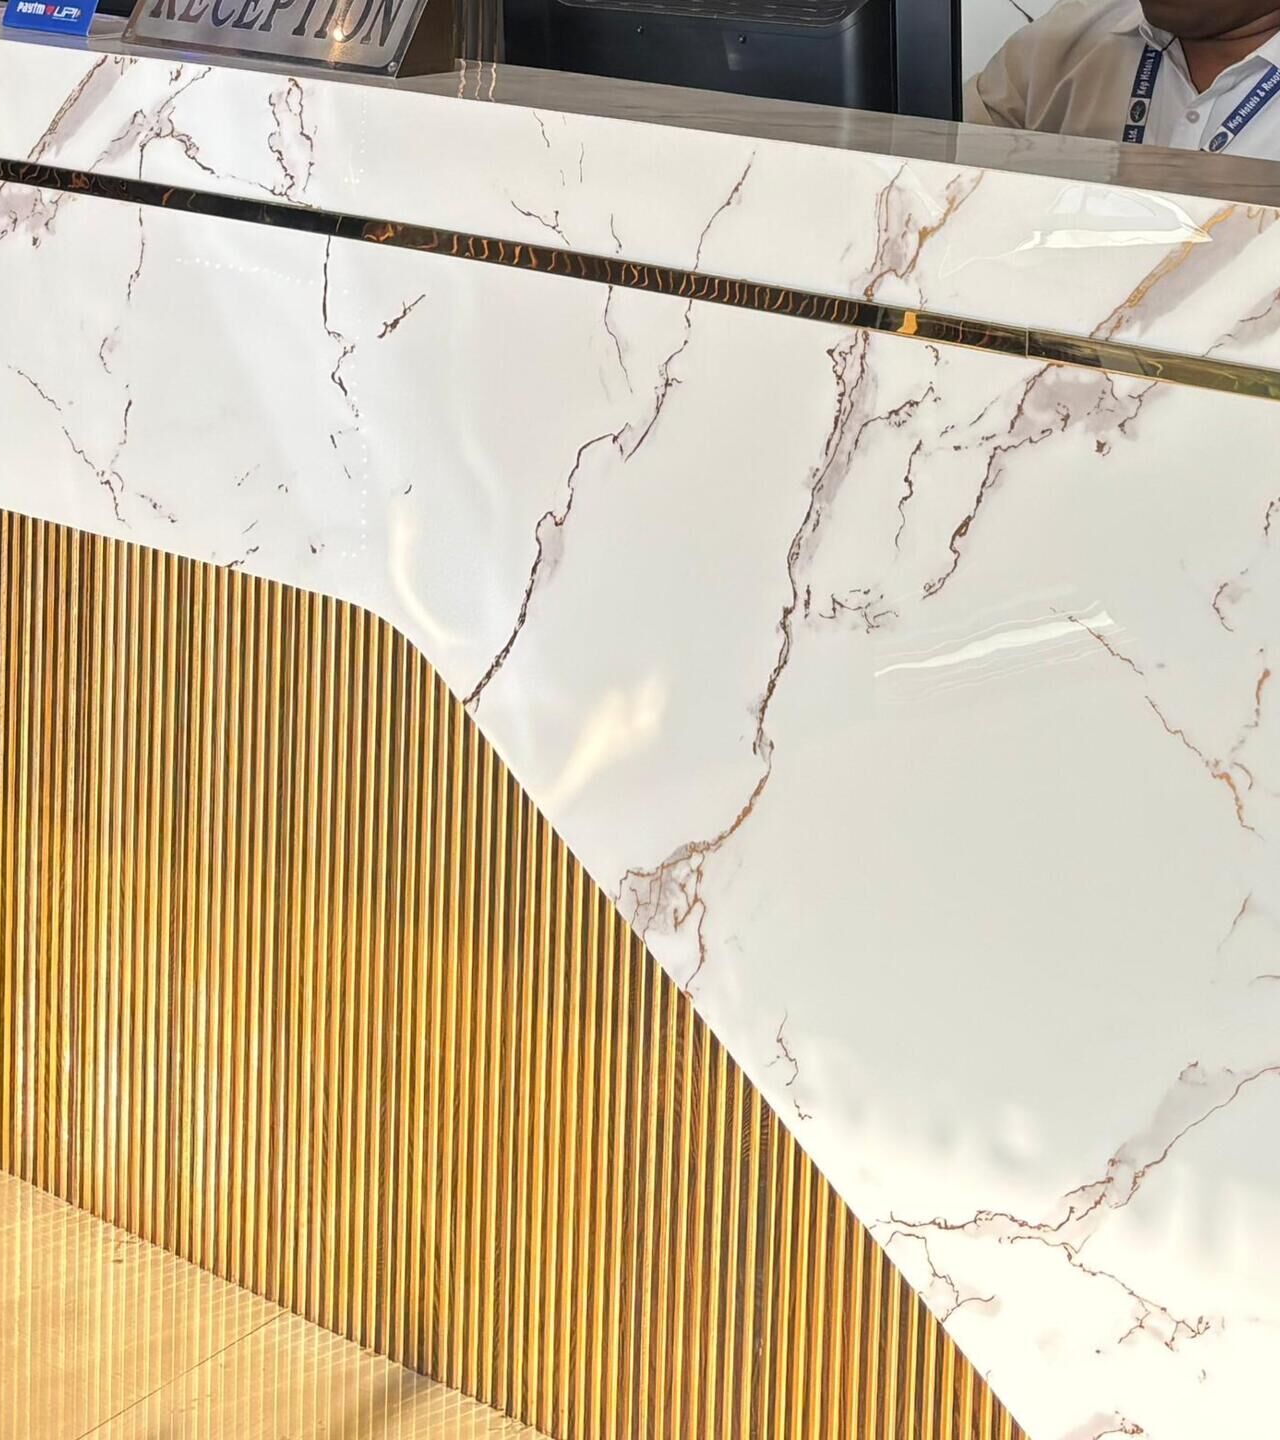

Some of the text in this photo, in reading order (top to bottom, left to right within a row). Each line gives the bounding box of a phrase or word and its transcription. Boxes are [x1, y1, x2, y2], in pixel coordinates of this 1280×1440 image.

[1226, 114, 1243, 130] Kep
[1238, 96, 1261, 118] Hotels
[1256, 88, 1266, 98] &
